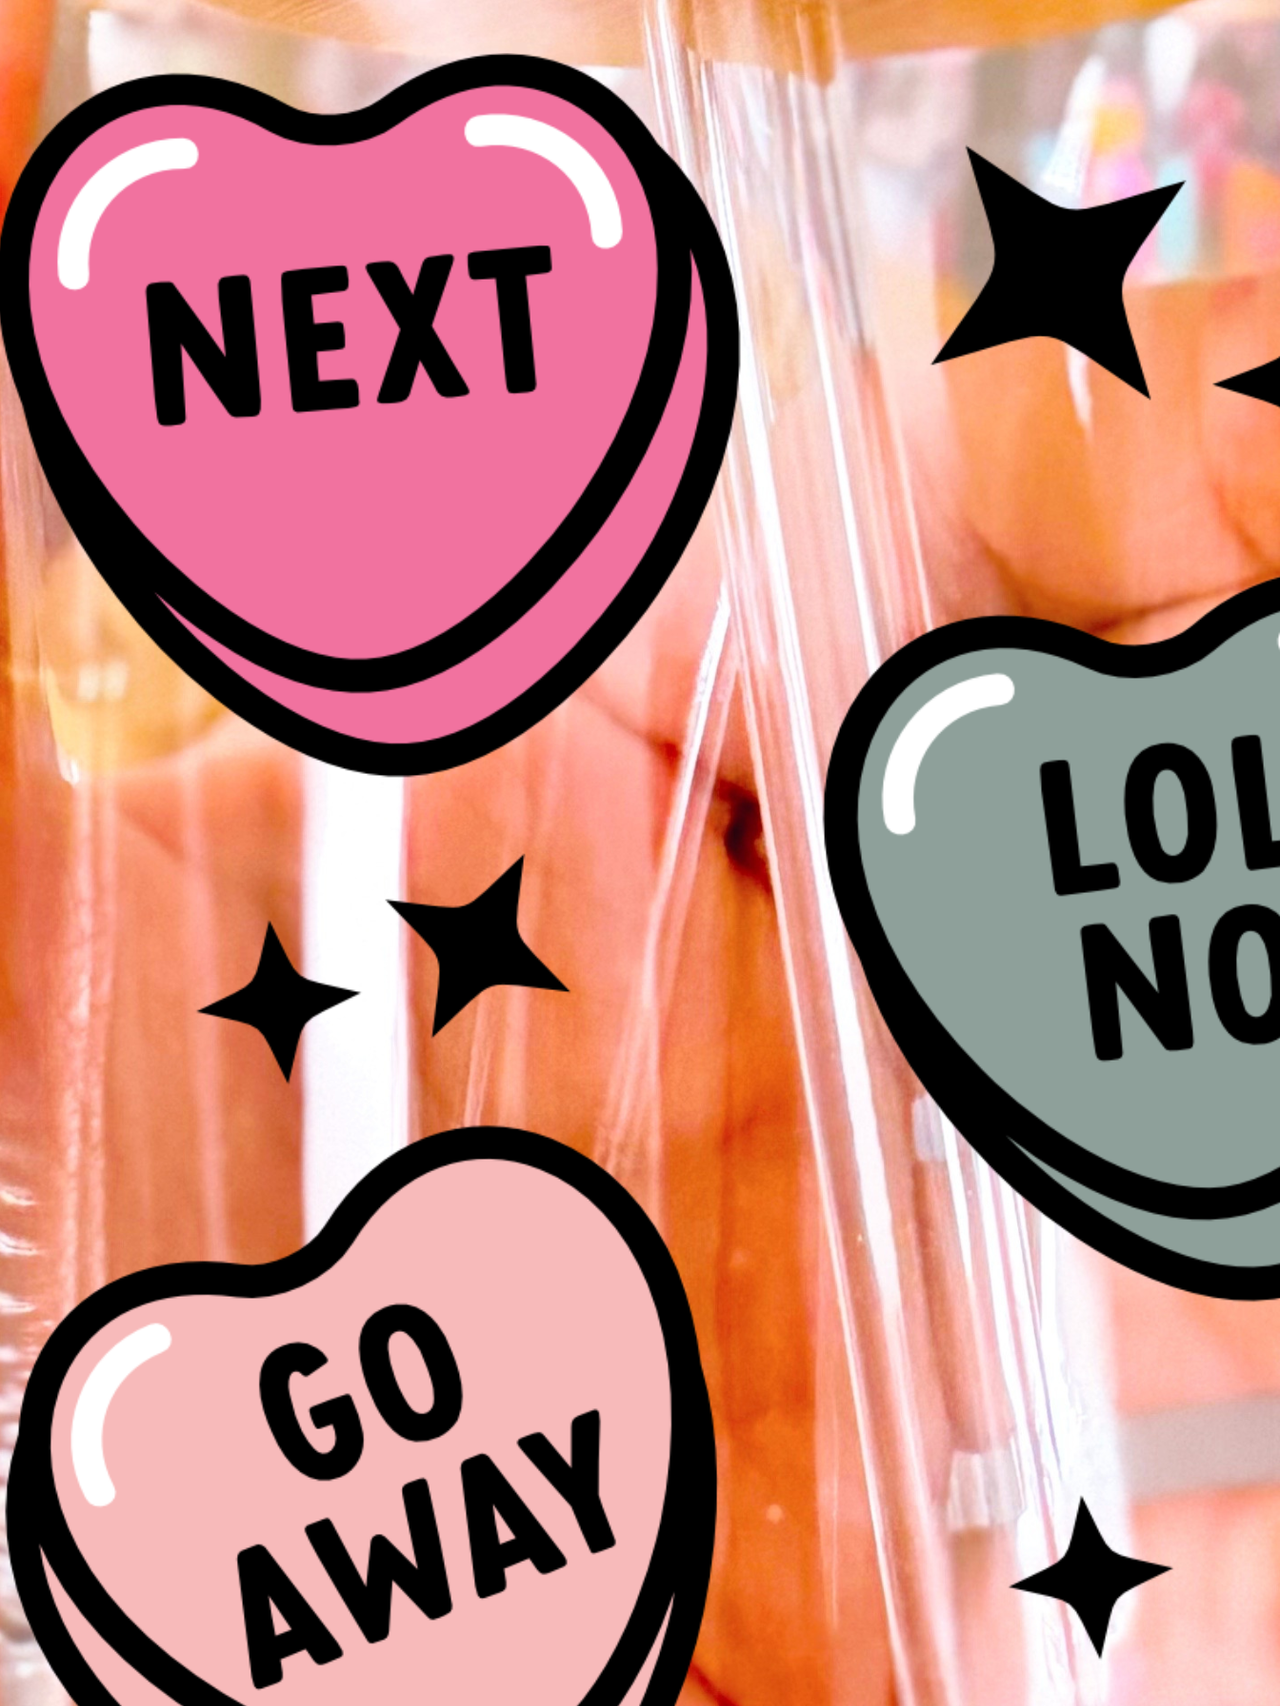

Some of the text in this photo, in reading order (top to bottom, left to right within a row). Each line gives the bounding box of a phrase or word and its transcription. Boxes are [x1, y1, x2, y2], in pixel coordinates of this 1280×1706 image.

[145, 245, 553, 426] NEXT
[259, 1304, 463, 1481] GO
[237, 1409, 616, 1690] AWAY
